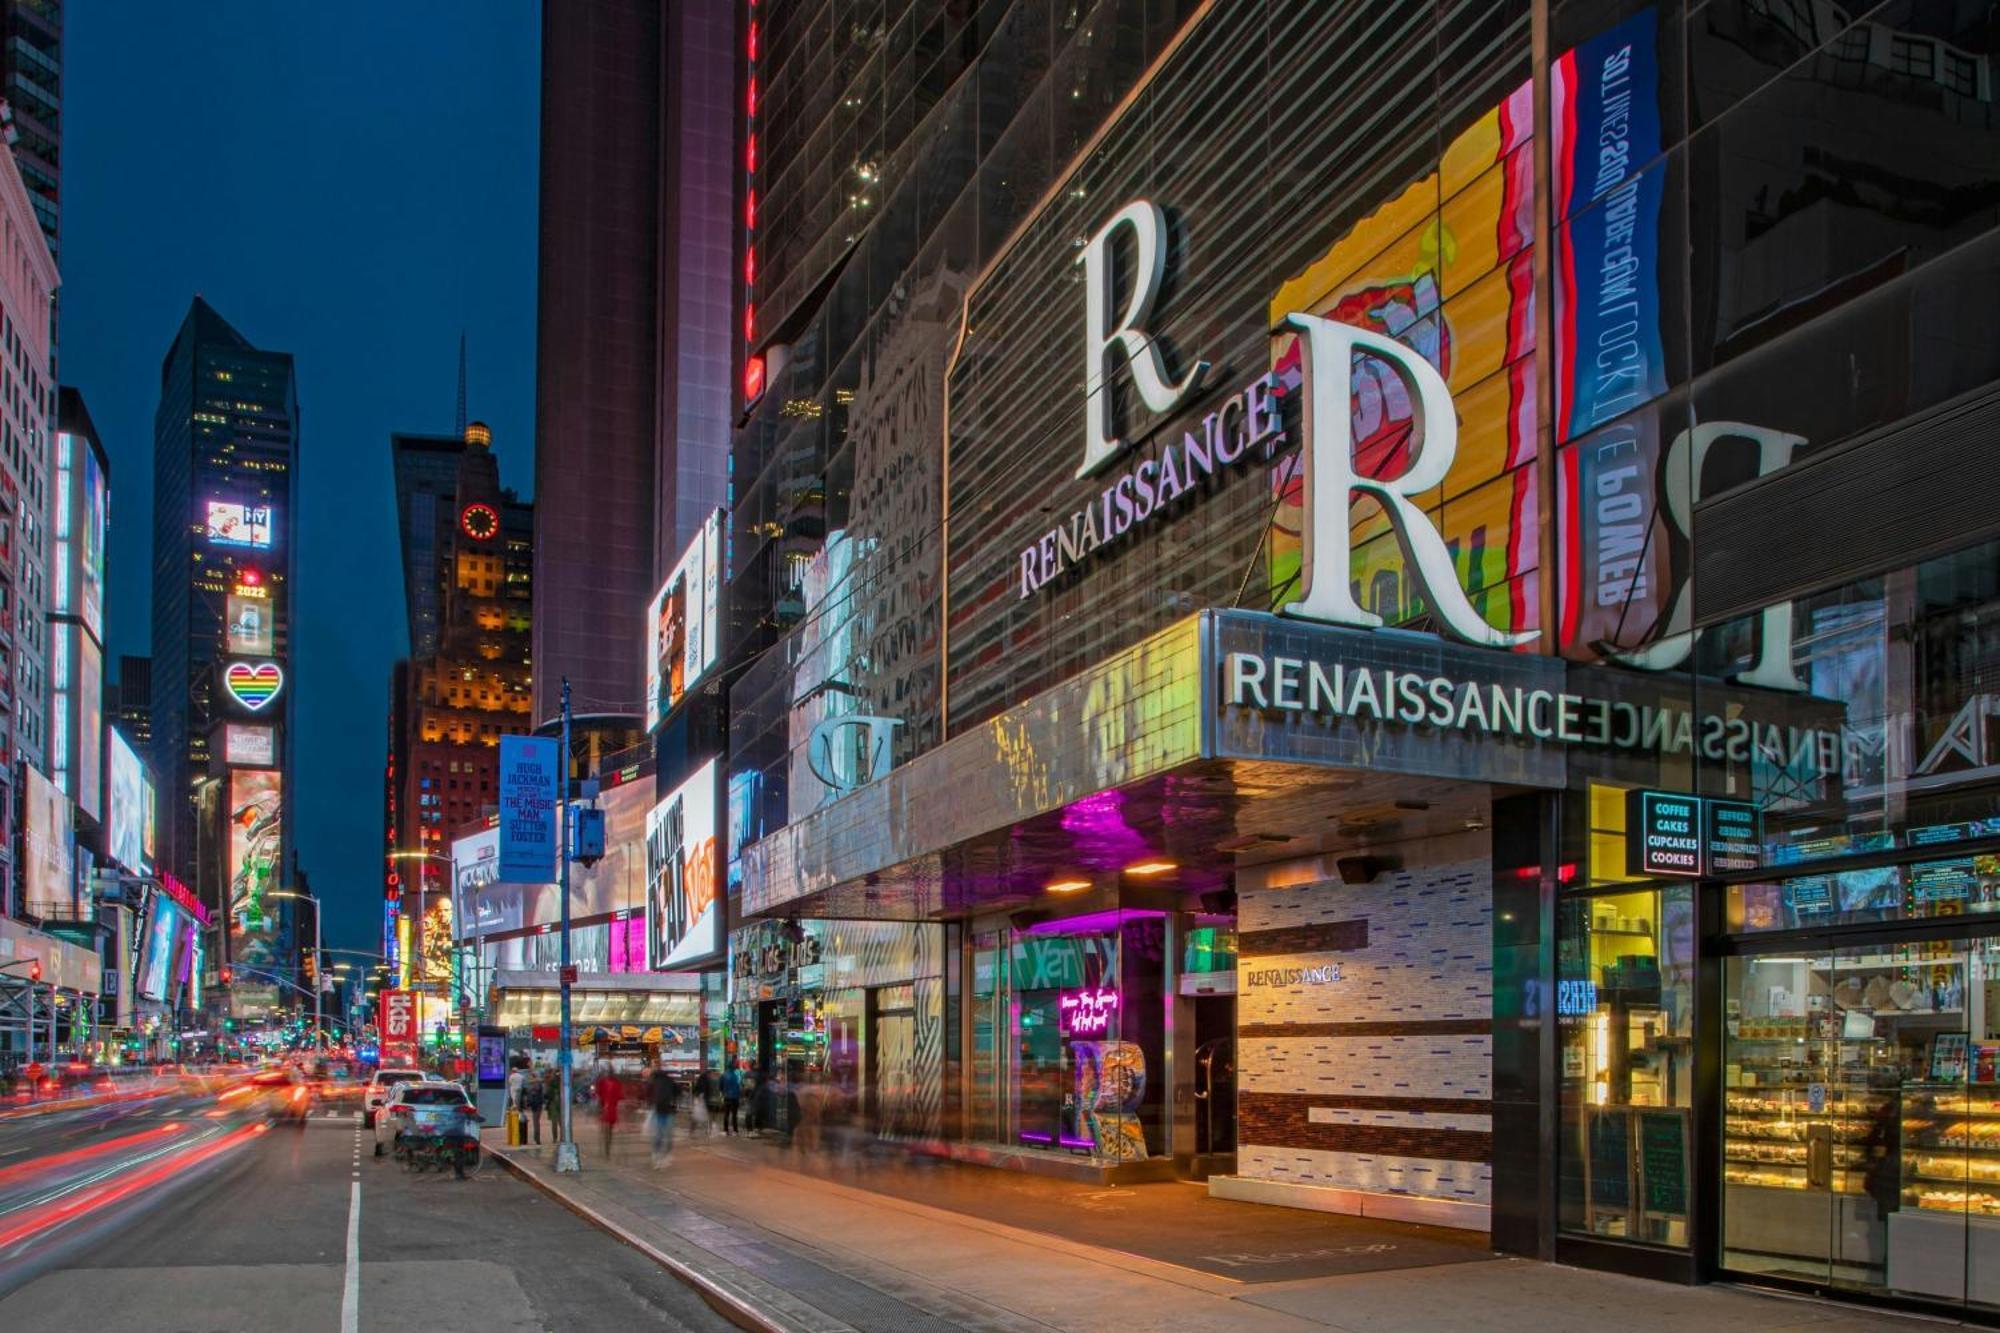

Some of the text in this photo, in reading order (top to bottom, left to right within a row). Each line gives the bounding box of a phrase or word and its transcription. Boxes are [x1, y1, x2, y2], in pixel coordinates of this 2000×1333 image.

[1075, 200, 1210, 480] R
[1018, 370, 1283, 600] RENAISSANCE
[1284, 311, 1542, 648] R
[236, 585, 266, 597] 2022
[1224, 653, 1584, 742] RENAISSANCE
[517, 763, 542, 774] HUGH
[508, 774, 551, 785] JACKMAN
[505, 797, 553, 810] THE MUSIC
[518, 809, 540, 820] MAN
[1655, 804, 1691, 817] COFFEE
[510, 820, 547, 832] SUTTON
[1656, 820, 1689, 833] CAKES
[512, 832, 546, 843] FOSTER
[647, 792, 684, 887] WALKING
[1648, 835, 1697, 850] CUPCAKES
[1651, 852, 1694, 866] COOKIES
[1247, 964, 1341, 987] RENAISSANCE
[388, 994, 412, 1036] tkts
